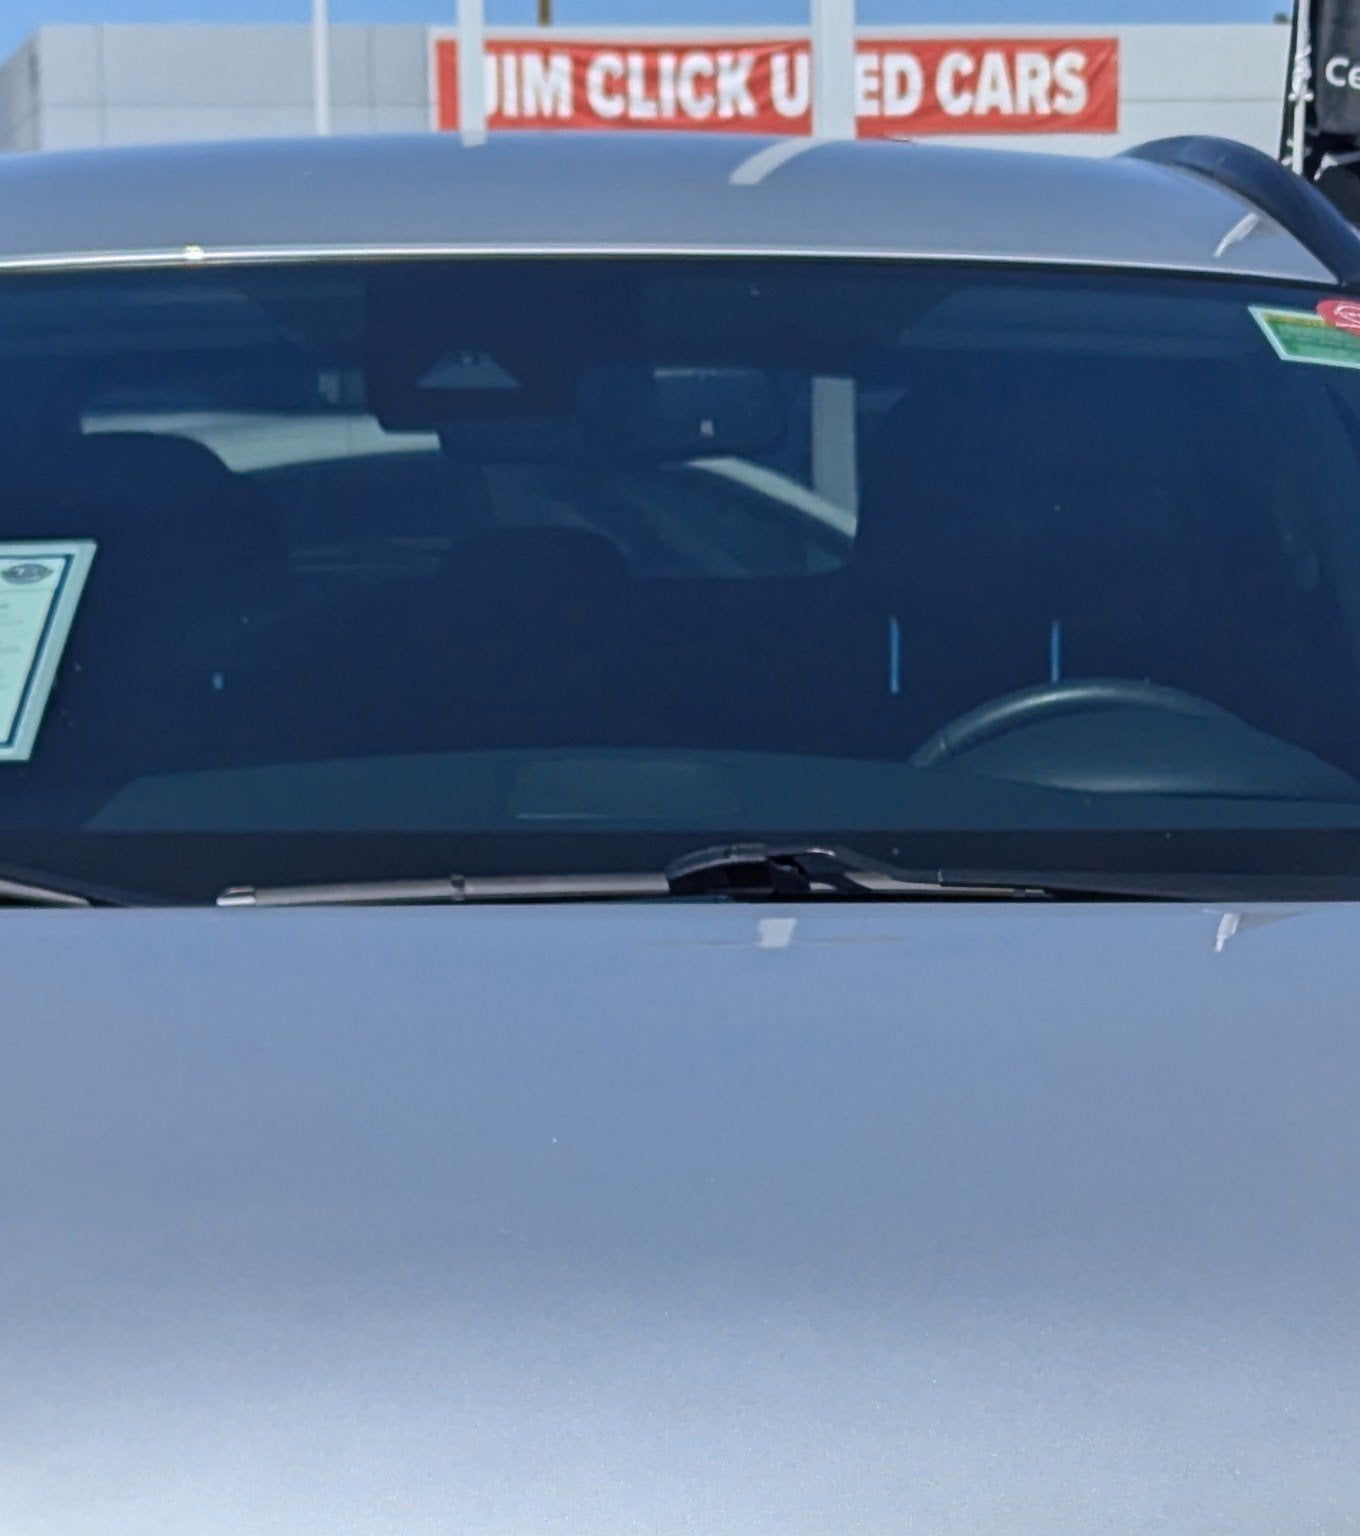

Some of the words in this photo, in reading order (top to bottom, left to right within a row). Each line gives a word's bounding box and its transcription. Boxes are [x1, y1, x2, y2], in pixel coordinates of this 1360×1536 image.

[482, 53, 574, 119] JIM
[586, 52, 758, 119] CLICK
[770, 52, 923, 118] UED
[936, 50, 1088, 117] CARS
